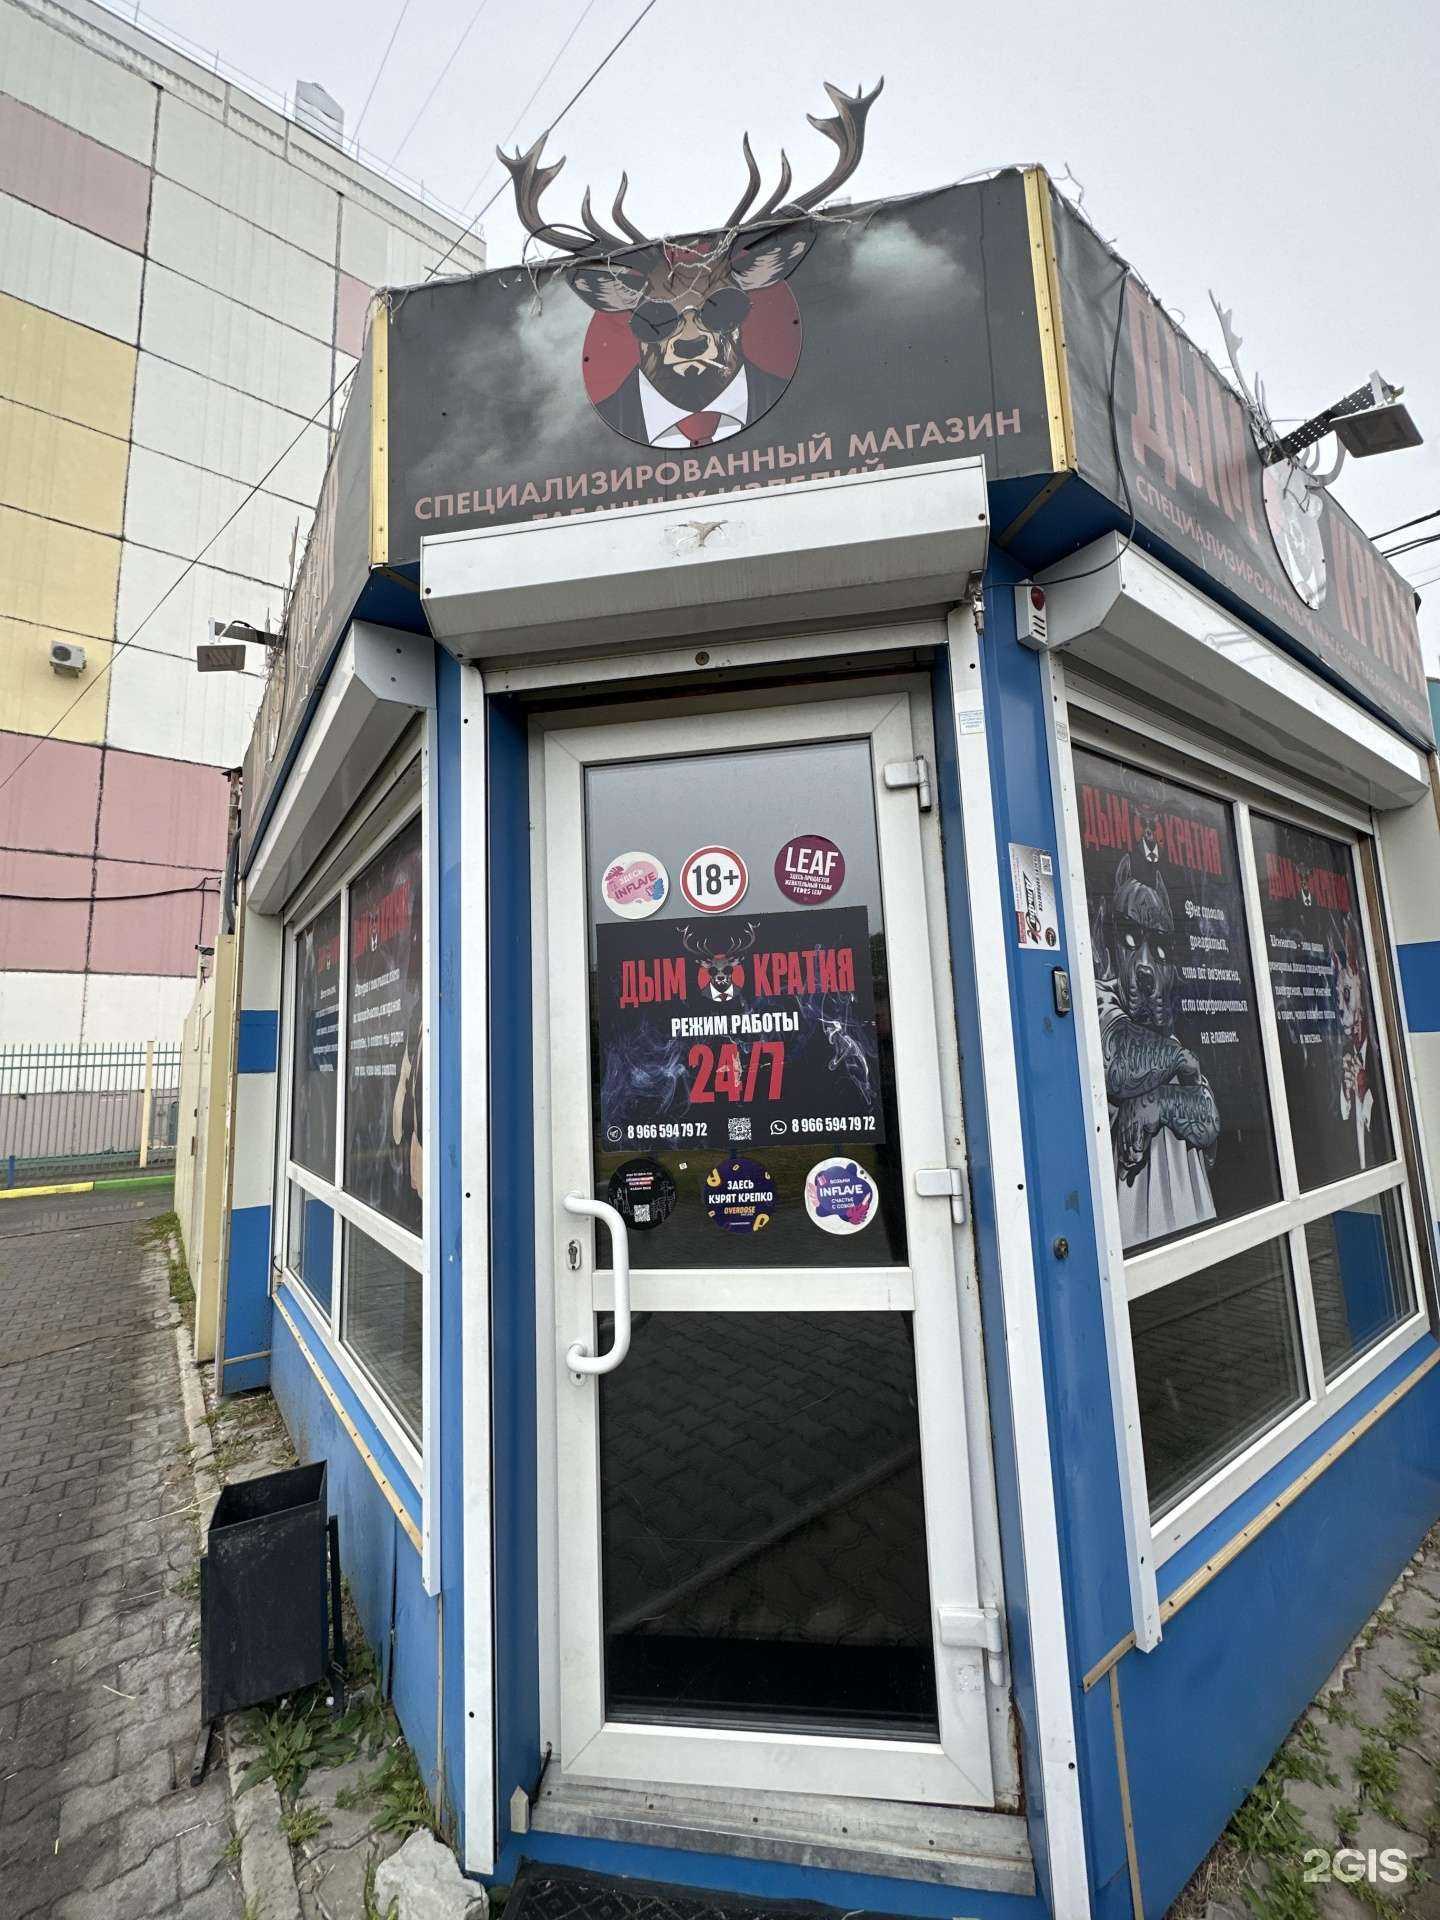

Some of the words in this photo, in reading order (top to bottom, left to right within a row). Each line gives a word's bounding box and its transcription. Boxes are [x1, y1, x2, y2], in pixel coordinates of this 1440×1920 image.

[1127, 278, 1260, 544] ДЫМ
[414, 432, 832, 521] СПЕЦИАЛИЗИРОВАННЫЙ
[848, 408, 1022, 456] МАГАЗИН
[1082, 784, 1132, 852] ДЫМ
[1164, 813, 1222, 875] КРАТИЯ
[785, 847, 839, 876] LEAF
[692, 864, 739, 896] 18+
[619, 958, 687, 1009] ДЫМ
[753, 948, 857, 997] КРАТИЯ
[672, 1015, 728, 1037] РЕЖИМ
[731, 1011, 799, 1034] РАБОТЫ
[688, 1041, 785, 1104] 24/7
[627, 1126, 634, 1139] 8
[636, 1124, 657, 1138] 966
[659, 1124, 679, 1138] 594
[681, 1123, 694, 1137] 79
[695, 1122, 708, 1137] 72
[791, 1119, 799, 1133] 8
[801, 1118, 823, 1132] 966
[825, 1117, 847, 1131] 594
[848, 1116, 861, 1131] 79
[863, 1116, 876, 1130] 72
[708, 1193, 737, 1204] КУРЯТ
[738, 1192, 773, 1203] КРЕПКО
[727, 1179, 754, 1190] ЗДЕСЬ
[724, 1206, 756, 1215] OVERDOSE
